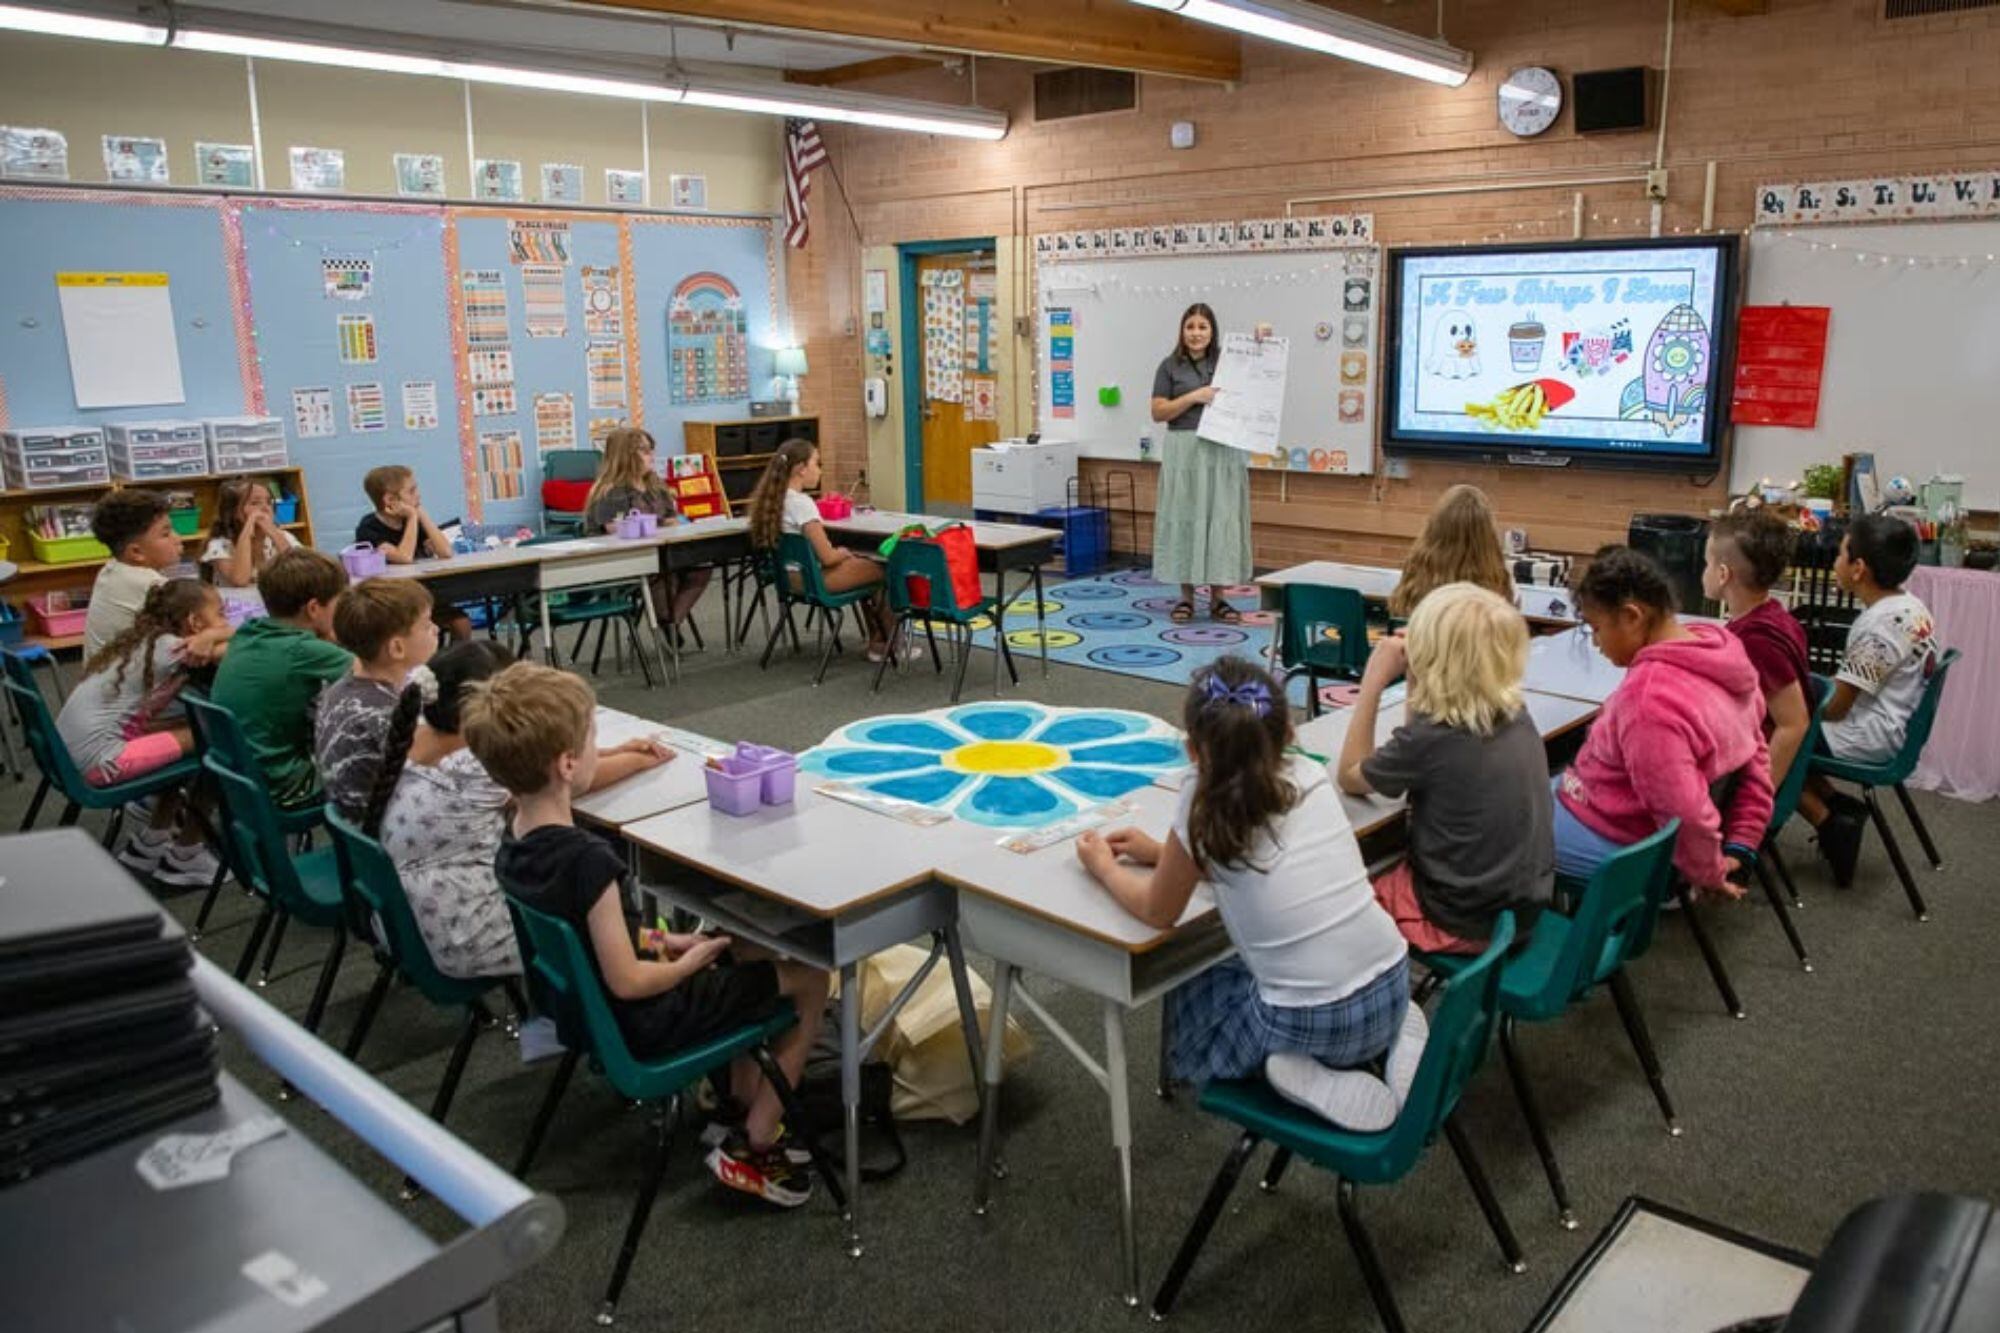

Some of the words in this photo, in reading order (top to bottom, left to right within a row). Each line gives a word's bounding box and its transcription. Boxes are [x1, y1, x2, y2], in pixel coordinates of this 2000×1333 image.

[1874, 185, 1894, 205] Tt
[1911, 183, 1936, 203] Uu
[1456, 280, 1508, 304] Few
[1513, 278, 1596, 312] Things
[1623, 276, 1690, 305] Love
